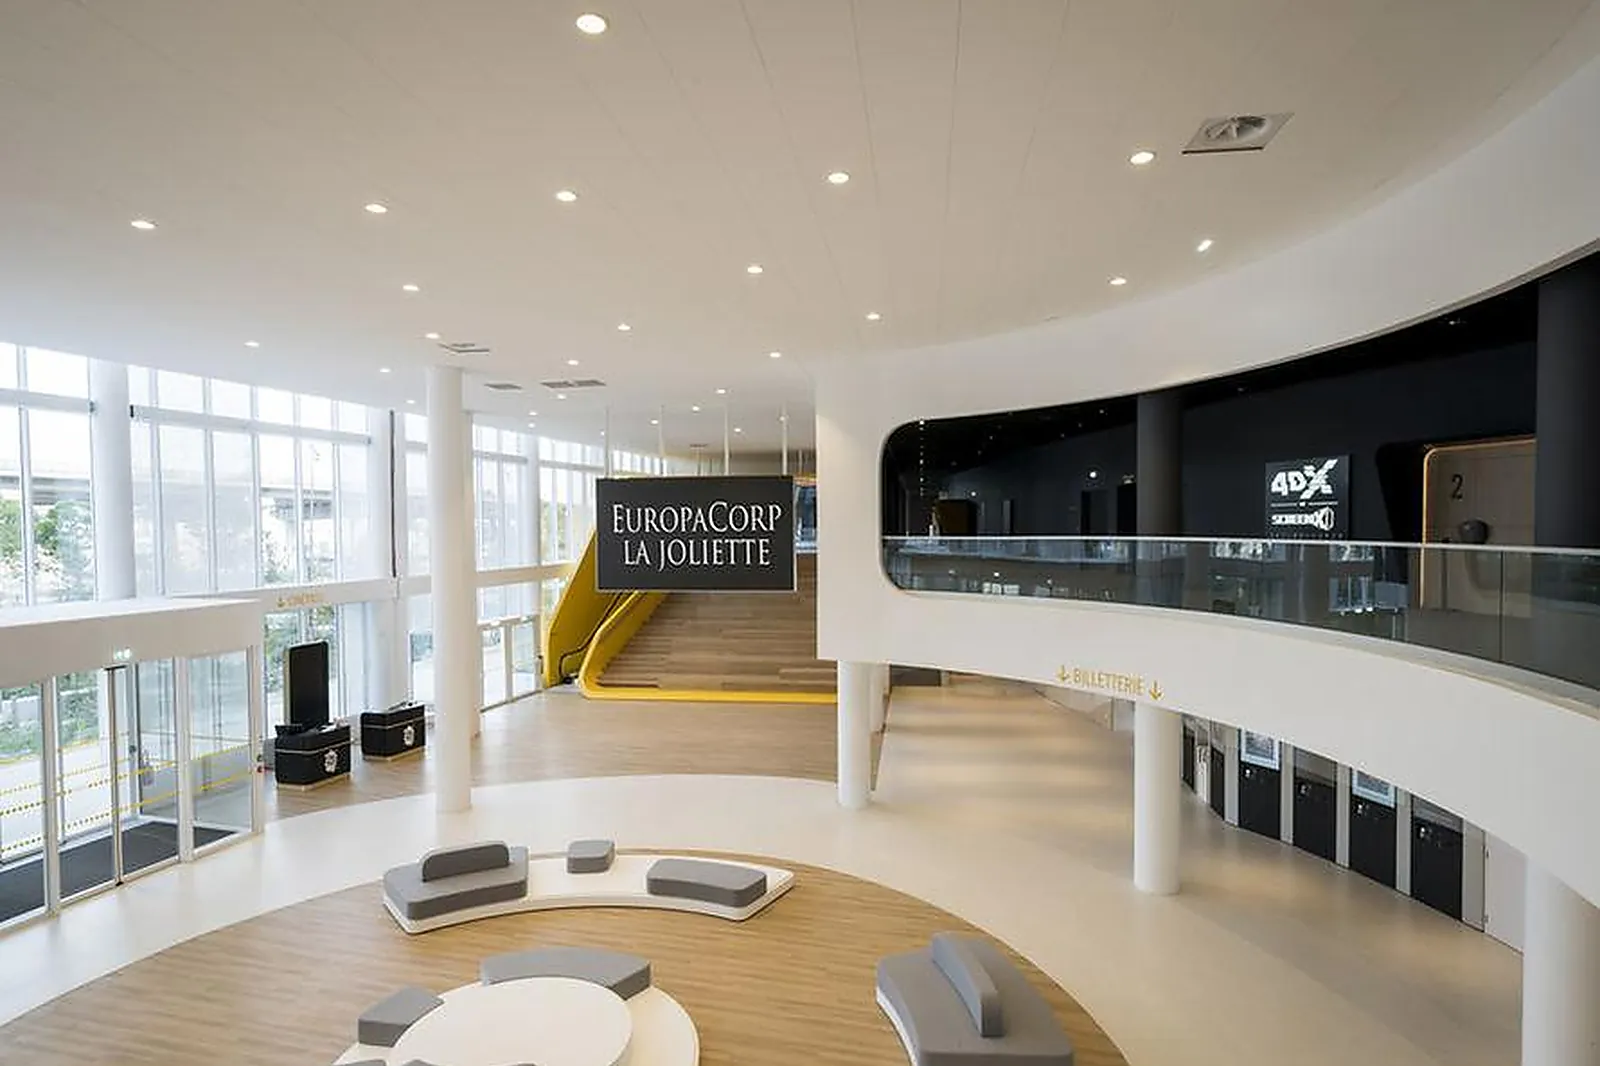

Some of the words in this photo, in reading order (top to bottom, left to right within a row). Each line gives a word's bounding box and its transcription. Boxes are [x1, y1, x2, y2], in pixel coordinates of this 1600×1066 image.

[1271, 459, 1338, 500] 4DX
[1451, 473, 1464, 500] 2
[624, 539, 651, 566] LA
[658, 538, 771, 573] JOLIETTE
[1072, 667, 1146, 697] BILLETTERIE
